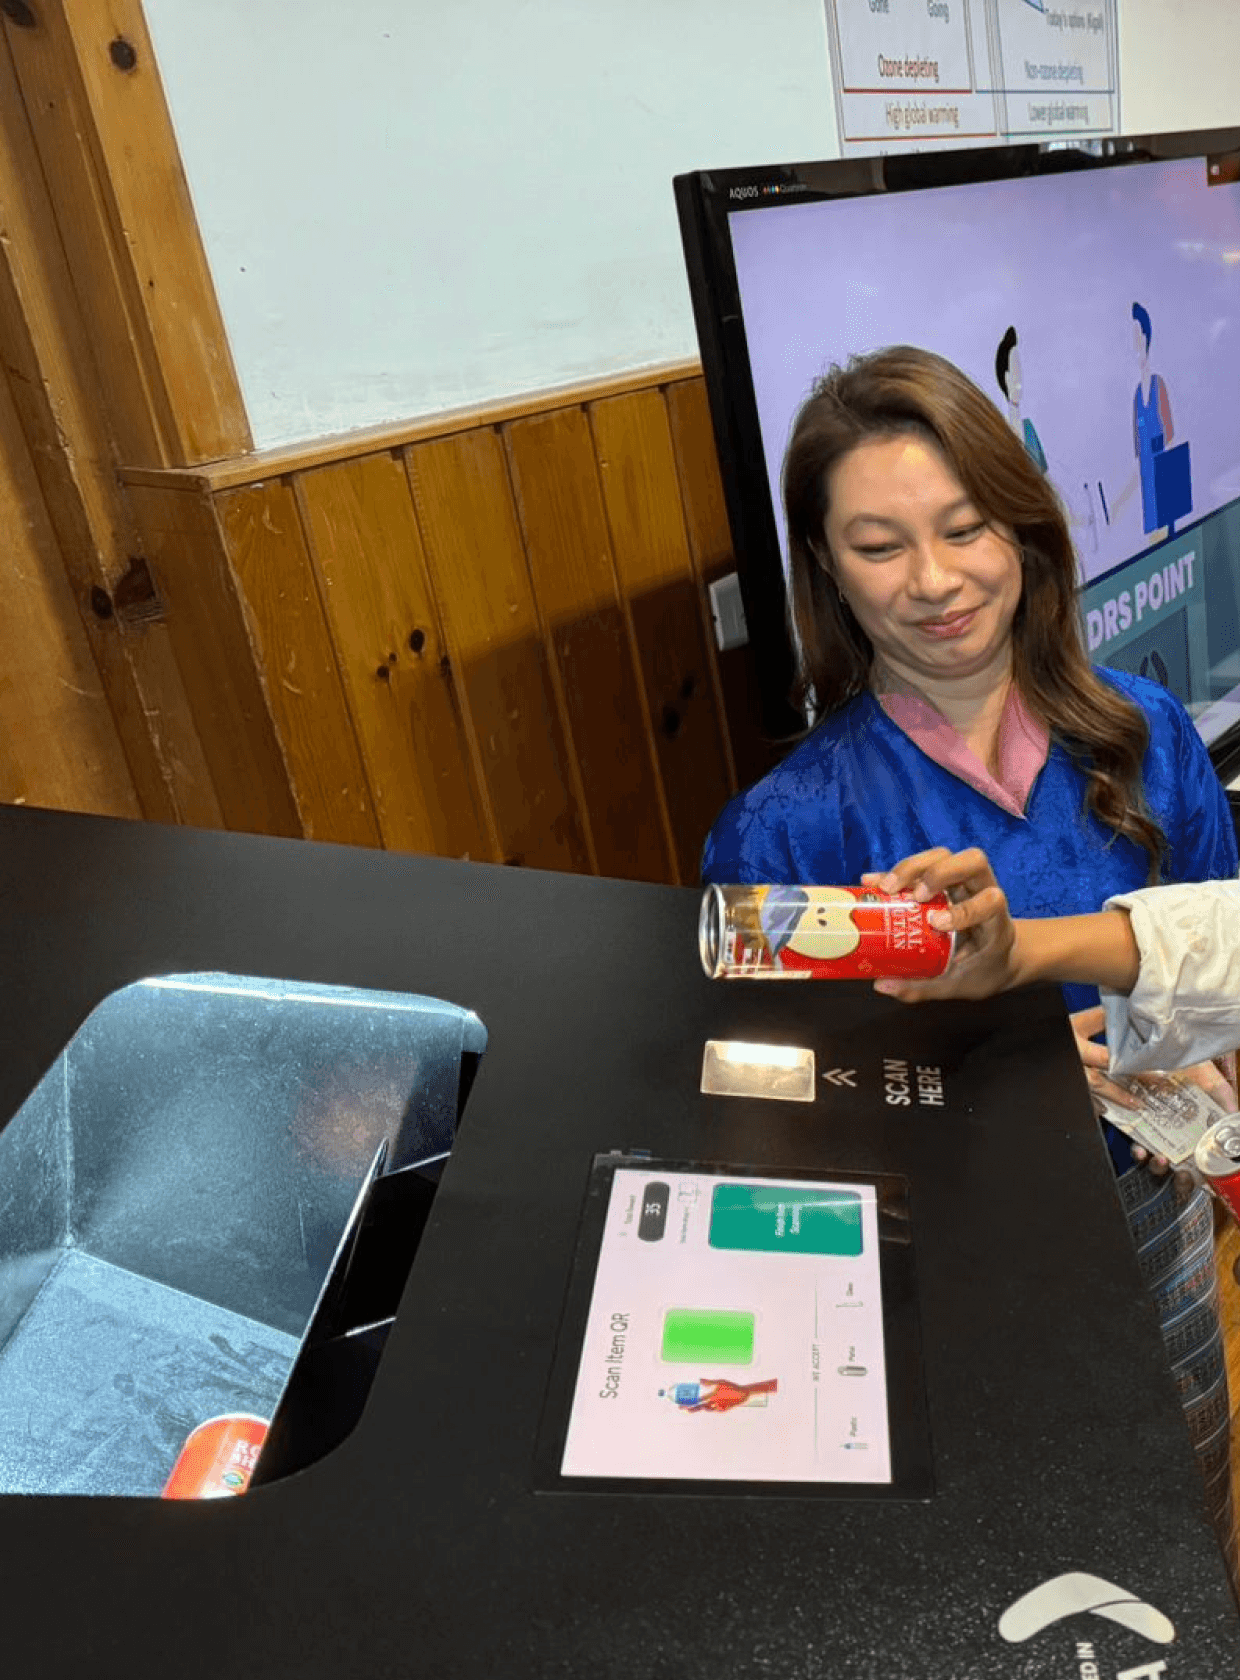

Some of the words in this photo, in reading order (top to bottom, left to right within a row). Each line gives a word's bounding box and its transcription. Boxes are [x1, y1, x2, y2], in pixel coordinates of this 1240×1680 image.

[878, 53, 902, 77] Ozone
[904, 53, 939, 83] depleting
[885, 101, 903, 130] High
[904, 101, 926, 130] global
[929, 103, 959, 129] warming
[729, 185, 759, 200] AQUOS
[1087, 591, 1132, 651] DRS
[1135, 551, 1195, 622] POINT
[883, 1058, 911, 1105] SCAN
[916, 1065, 945, 1105] HERE
[644, 1203, 661, 1216] 35
[610, 1312, 630, 1332] QR
[605, 1334, 626, 1363] Item
[599, 1366, 622, 1399] Scan
[1075, 1642, 1095, 1660] IN
